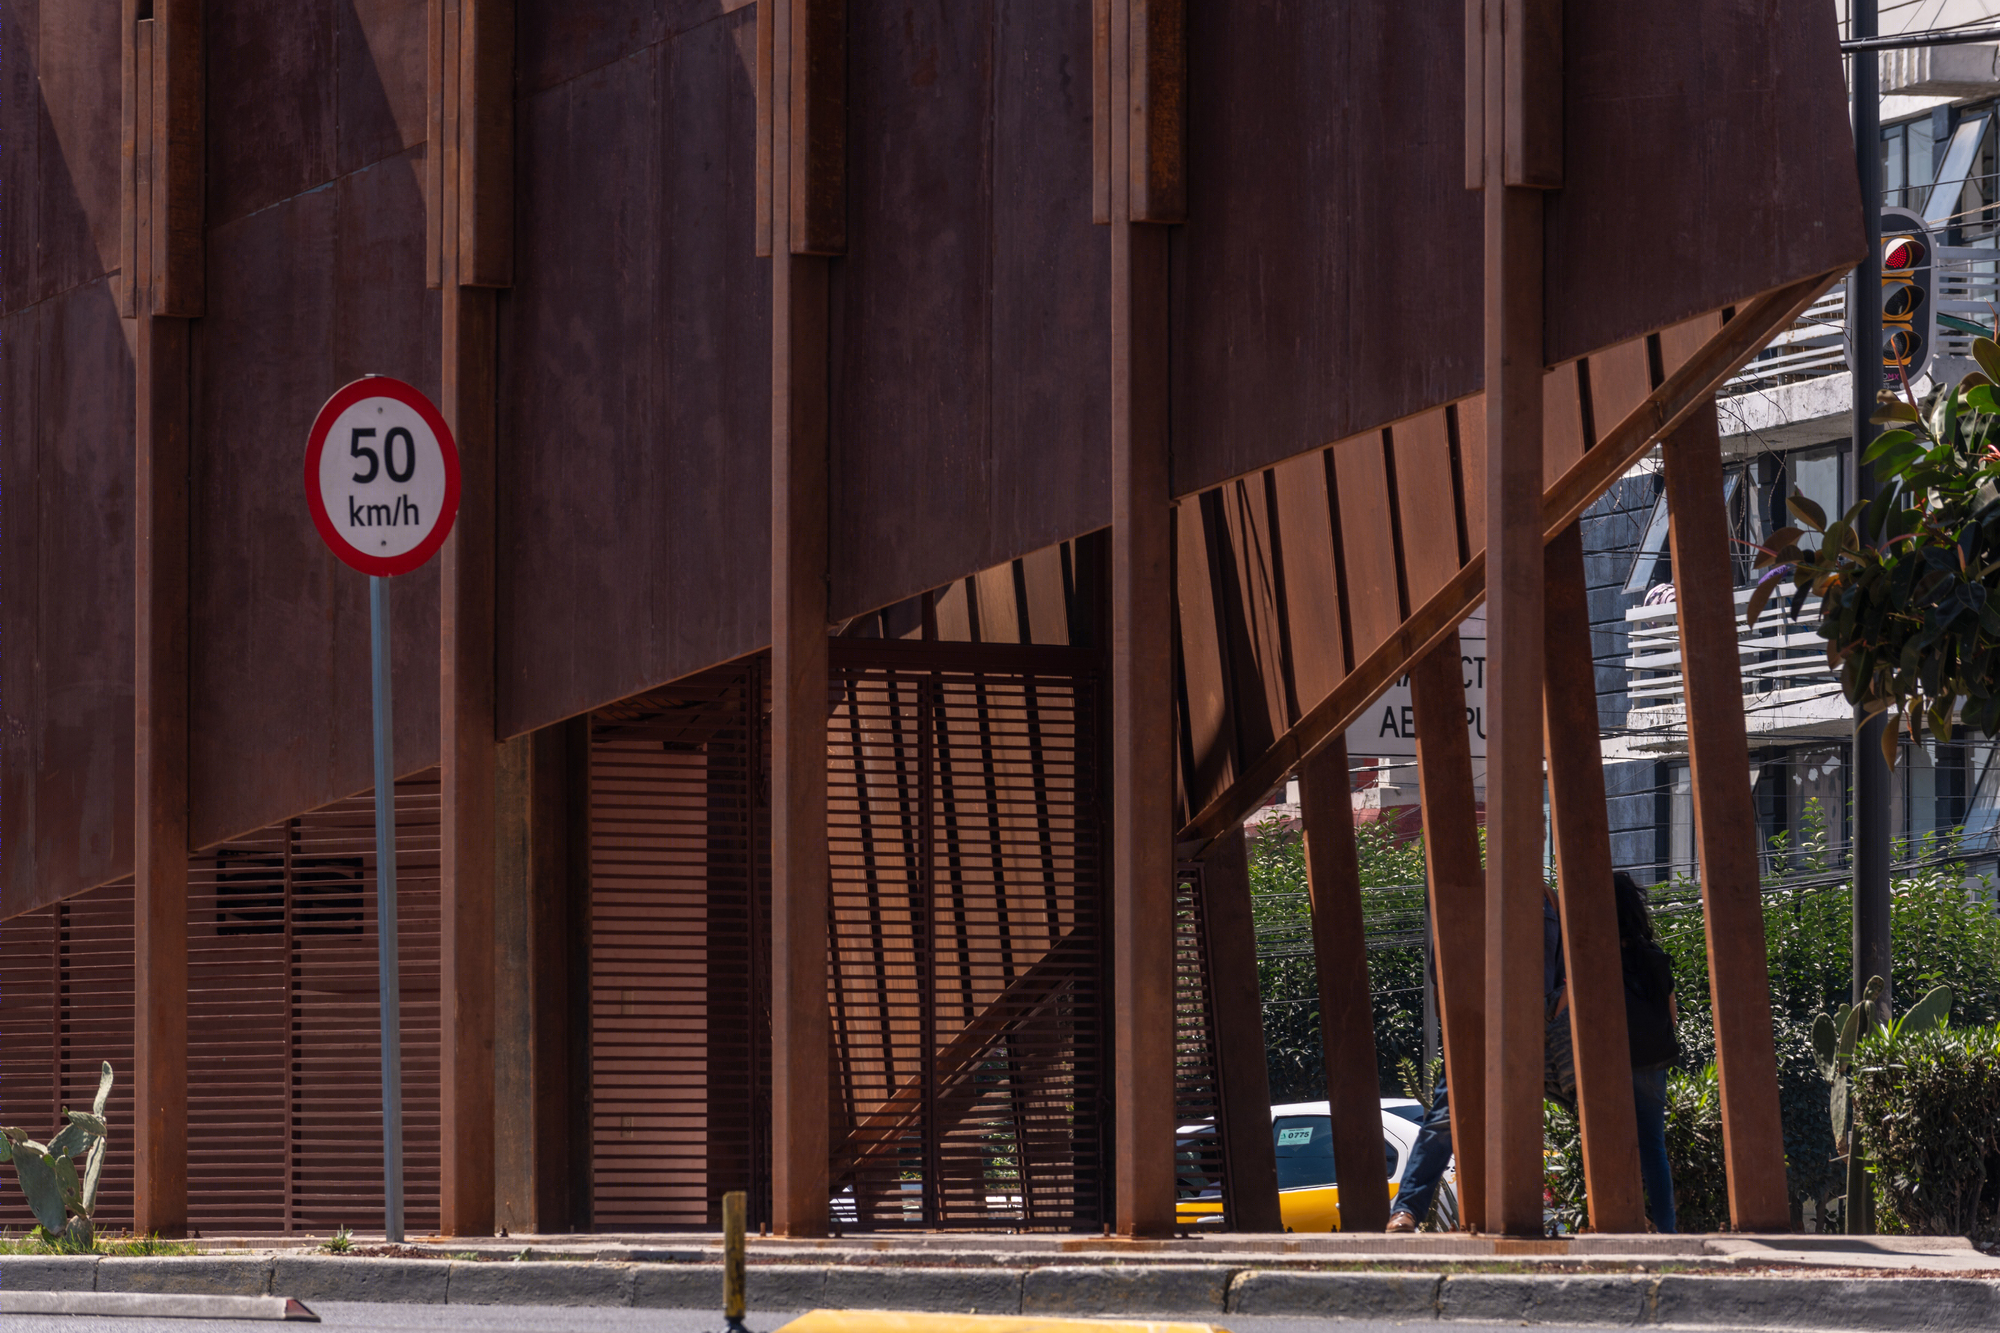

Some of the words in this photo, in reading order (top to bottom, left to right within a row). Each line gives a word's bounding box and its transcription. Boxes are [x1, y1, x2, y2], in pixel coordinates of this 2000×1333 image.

[350, 426, 416, 484] 50
[349, 494, 420, 527] km/h
[1288, 1131, 1310, 1139] 0775
